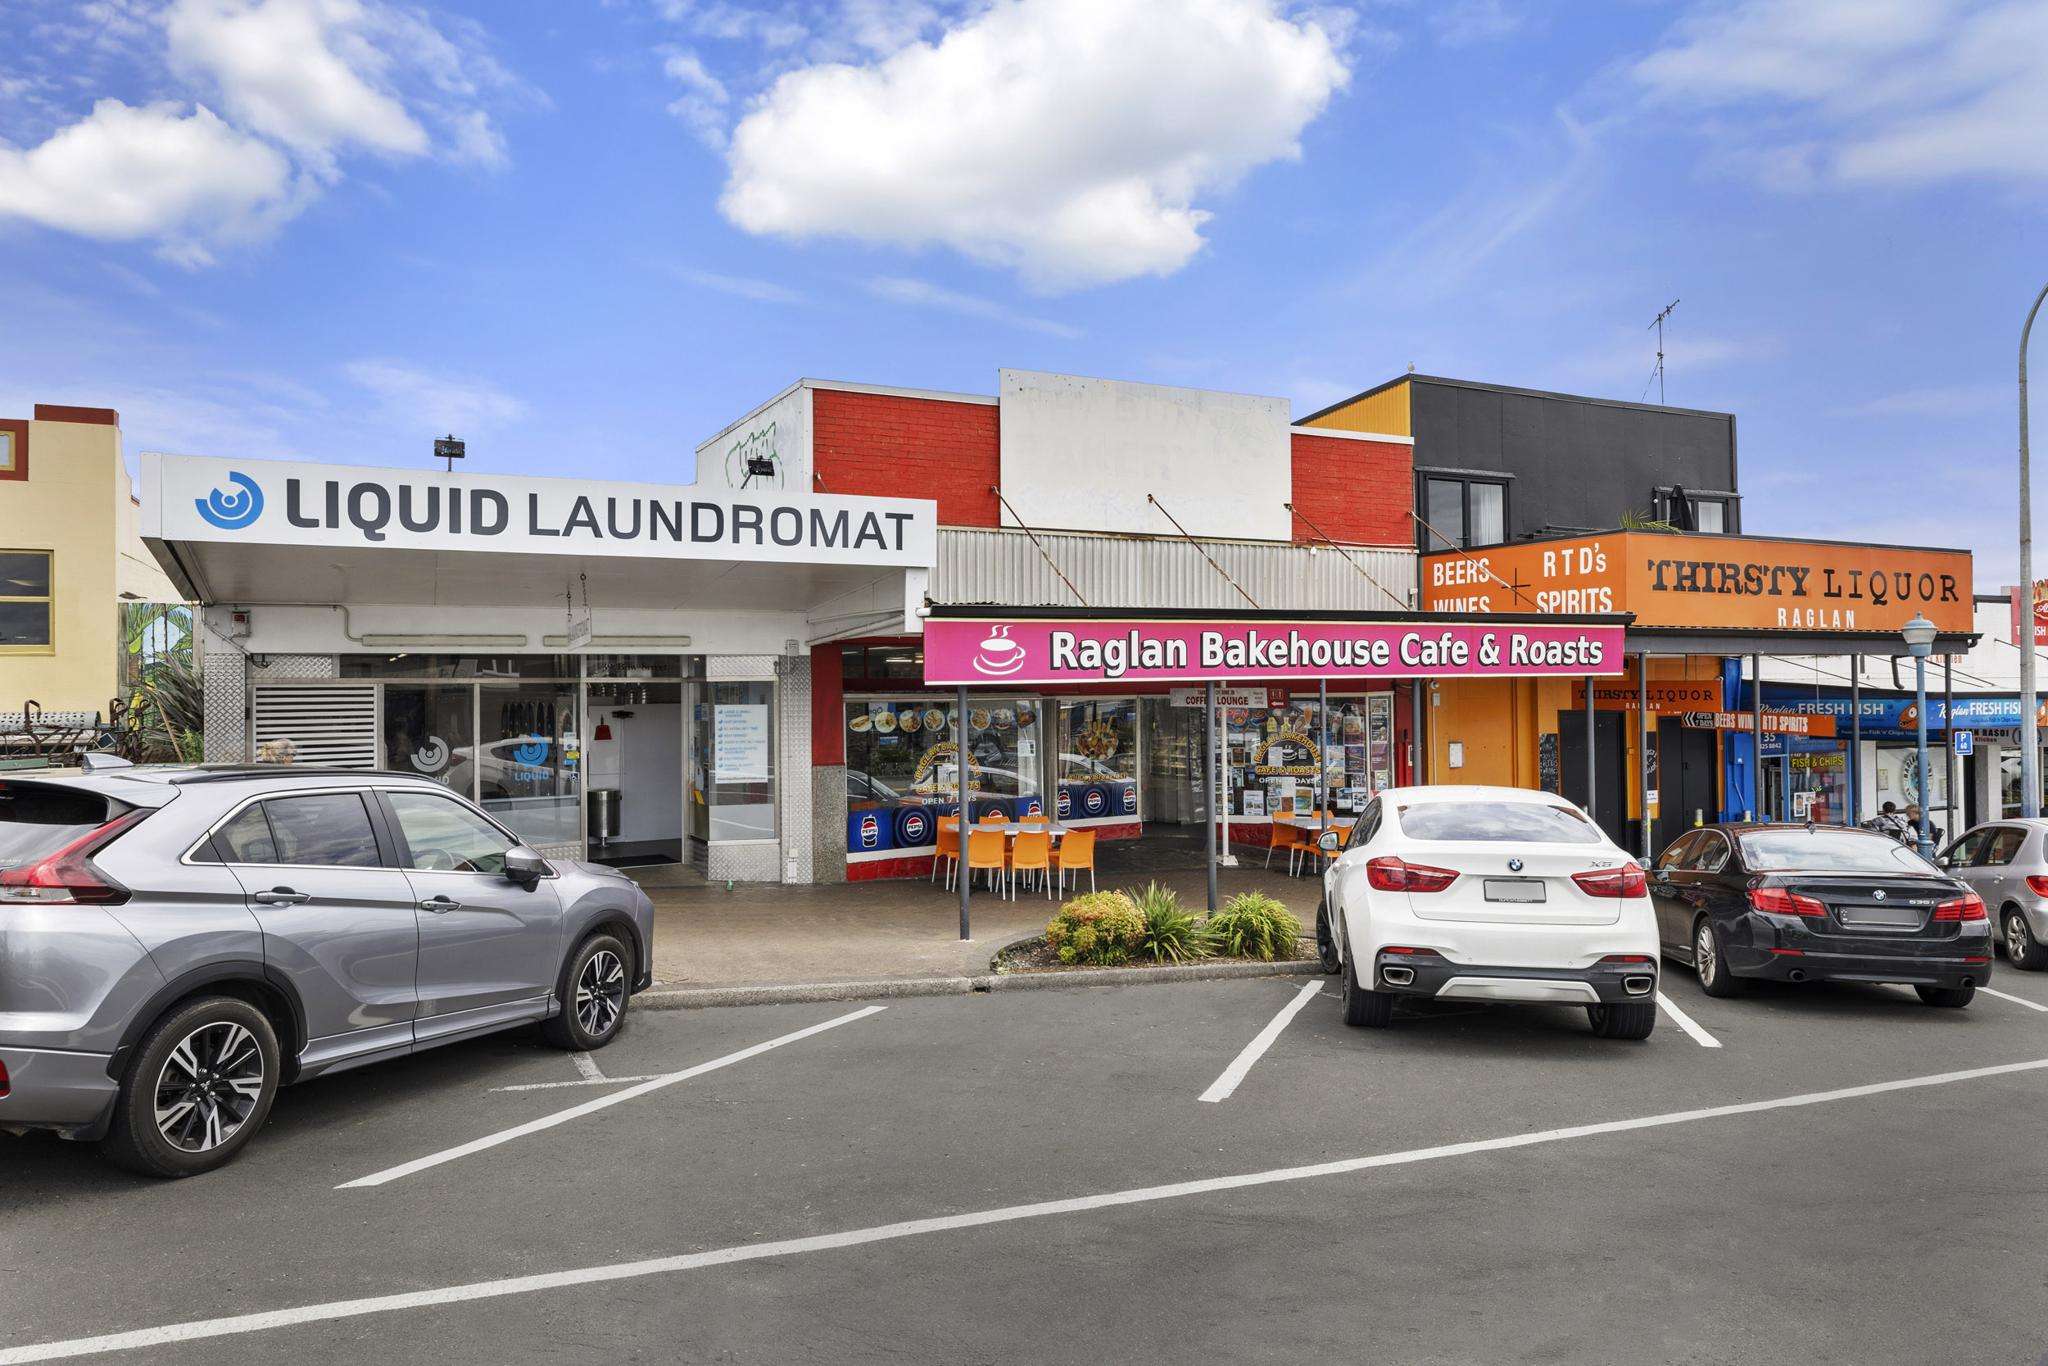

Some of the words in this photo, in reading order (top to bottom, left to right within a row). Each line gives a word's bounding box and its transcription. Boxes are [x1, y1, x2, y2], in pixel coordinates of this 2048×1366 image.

[286, 478, 510, 542] LIQUID
[528, 492, 914, 551] LAUNDROMAT
[1433, 558, 1490, 586] BEERS
[1647, 559, 1810, 597] THIRSTY
[1824, 568, 1959, 606] LIQUOR
[1536, 586, 1613, 614] SPIRITS
[1777, 607, 1855, 629] RAGLAN
[1050, 629, 1188, 679] Raglan
[1200, 629, 1391, 669] Bakehouse
[1400, 631, 1469, 667] Cafe
[1478, 632, 1501, 667] &
[1510, 633, 1604, 667] Roasts
[1217, 697, 1249, 706] LOUNGE
[1645, 689, 1714, 703] LIQUOR
[1798, 703, 1845, 715] FRESH
[1970, 702, 2001, 715] FRESH
[1714, 712, 1736, 728] BEERS
[1762, 715, 1777, 731] RTD
[1780, 716, 1808, 733] SPIRITS
[1763, 732, 1776, 742] 35
[1960, 733, 1967, 742] P
[1791, 758, 1810, 768] FISH
[1819, 756, 1843, 767] CHIPS
[514, 771, 550, 783] LIQUID
[922, 796, 944, 805] OPEN
